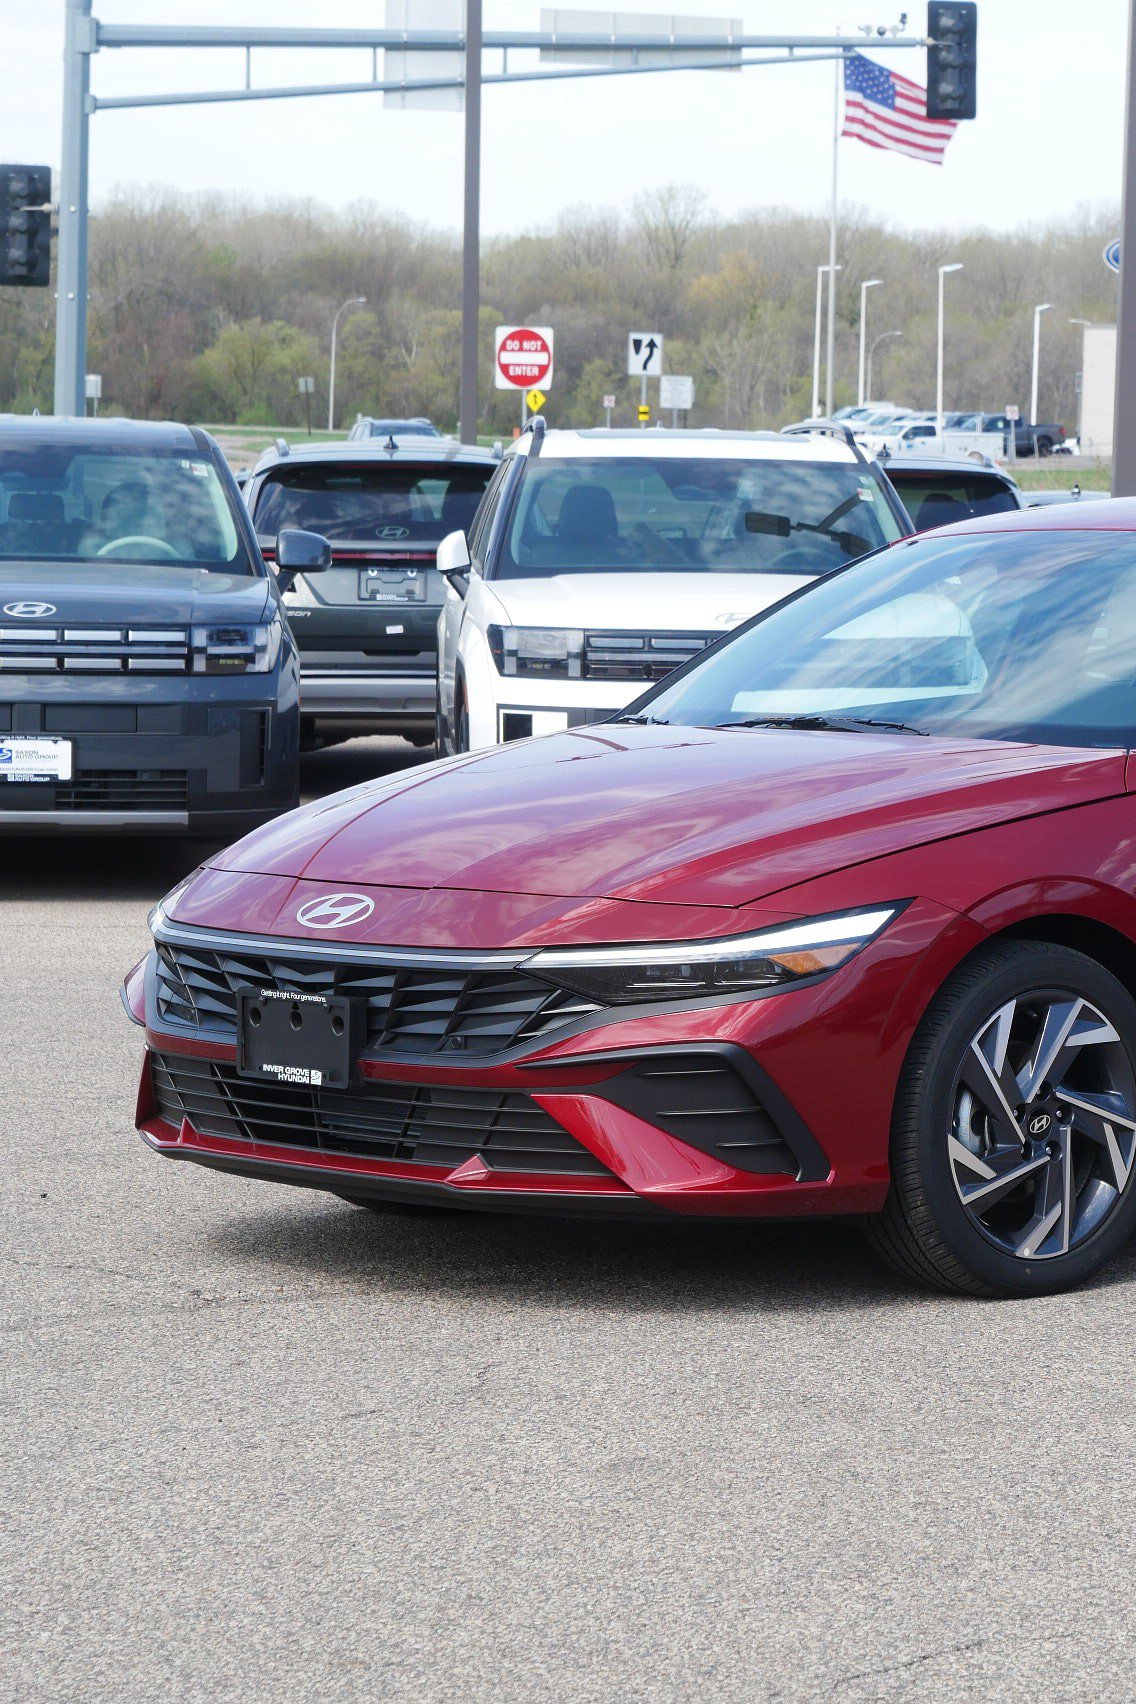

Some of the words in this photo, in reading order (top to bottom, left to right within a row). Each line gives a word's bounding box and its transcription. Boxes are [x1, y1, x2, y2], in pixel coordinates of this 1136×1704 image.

[506, 340, 520, 350] DO
[523, 340, 542, 350] NOT
[509, 366, 539, 376] ENTER
[260, 989, 276, 998] Getting
[262, 1064, 284, 1074] INVER
[285, 1066, 310, 1076] GROVE
[278, 1073, 310, 1084] HYUNDAI
